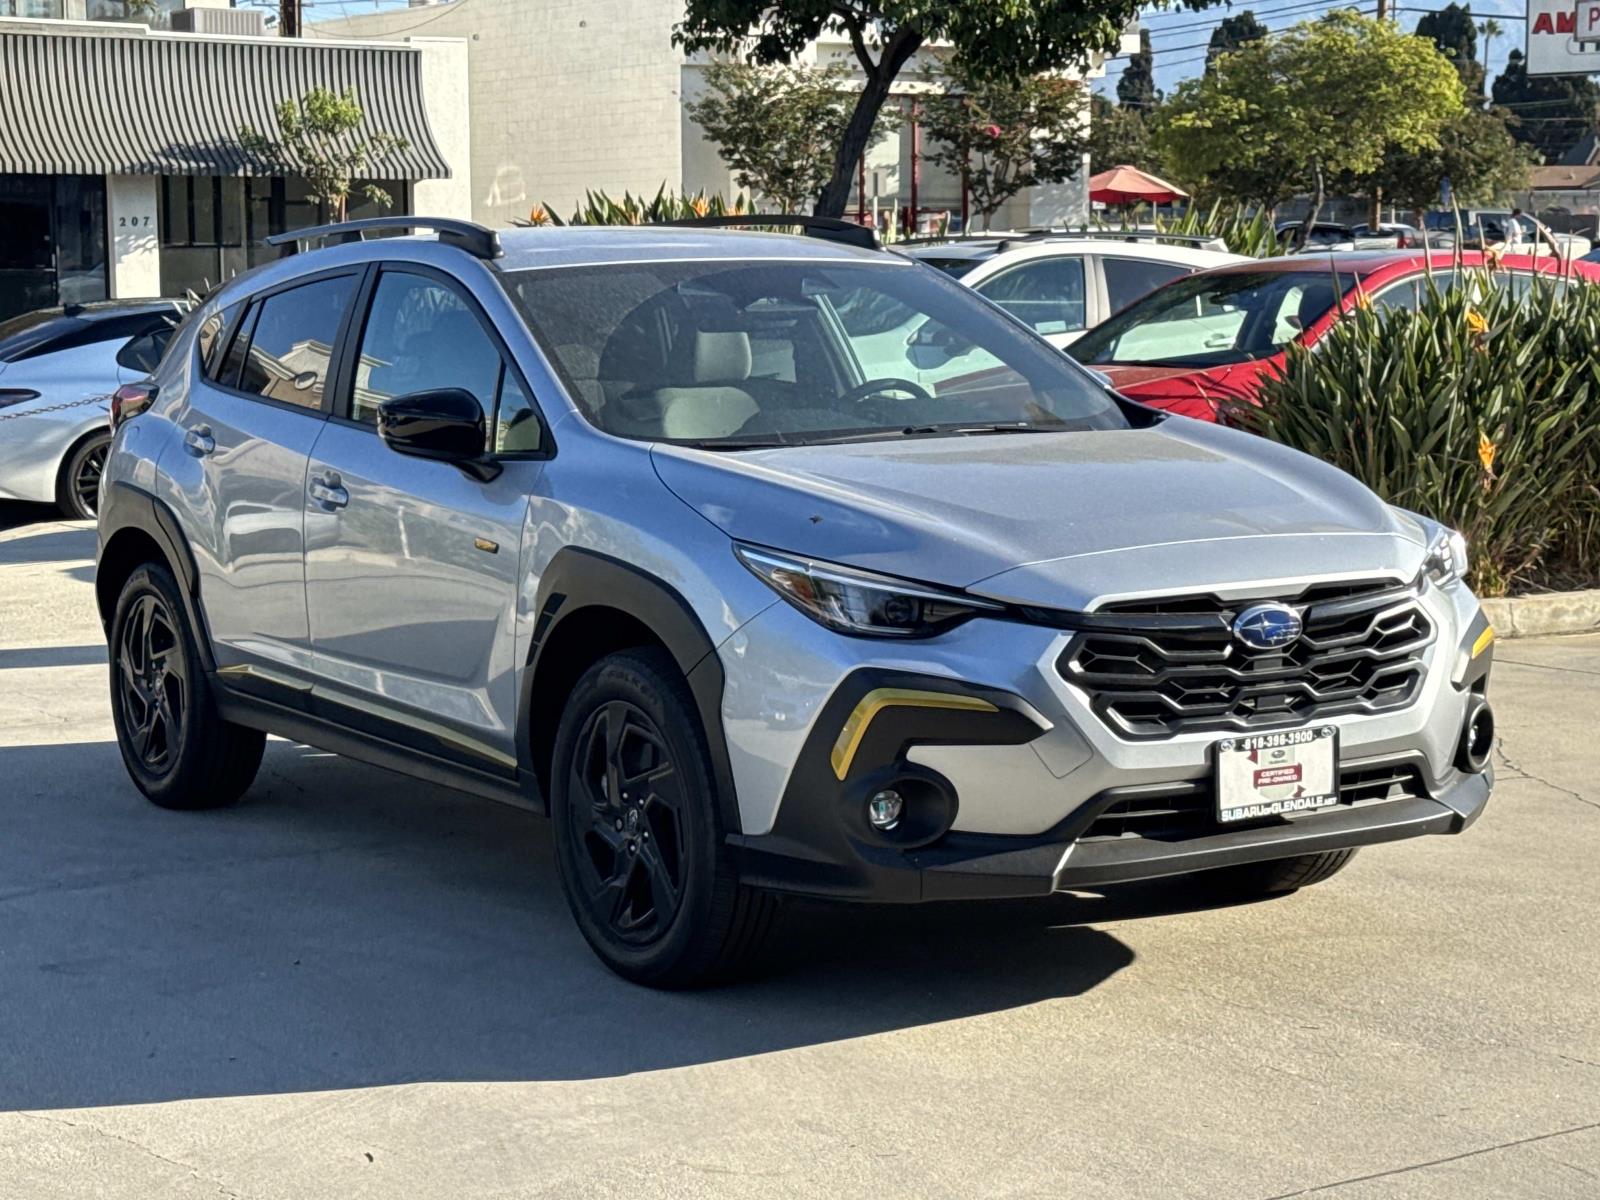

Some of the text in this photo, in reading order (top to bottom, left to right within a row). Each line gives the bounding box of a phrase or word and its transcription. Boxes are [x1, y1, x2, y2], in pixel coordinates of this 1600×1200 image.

[119, 216, 150, 227] 207
[1261, 768, 1295, 778] CERTIFIED
[1258, 774, 1298, 784] PRE-OWNED
